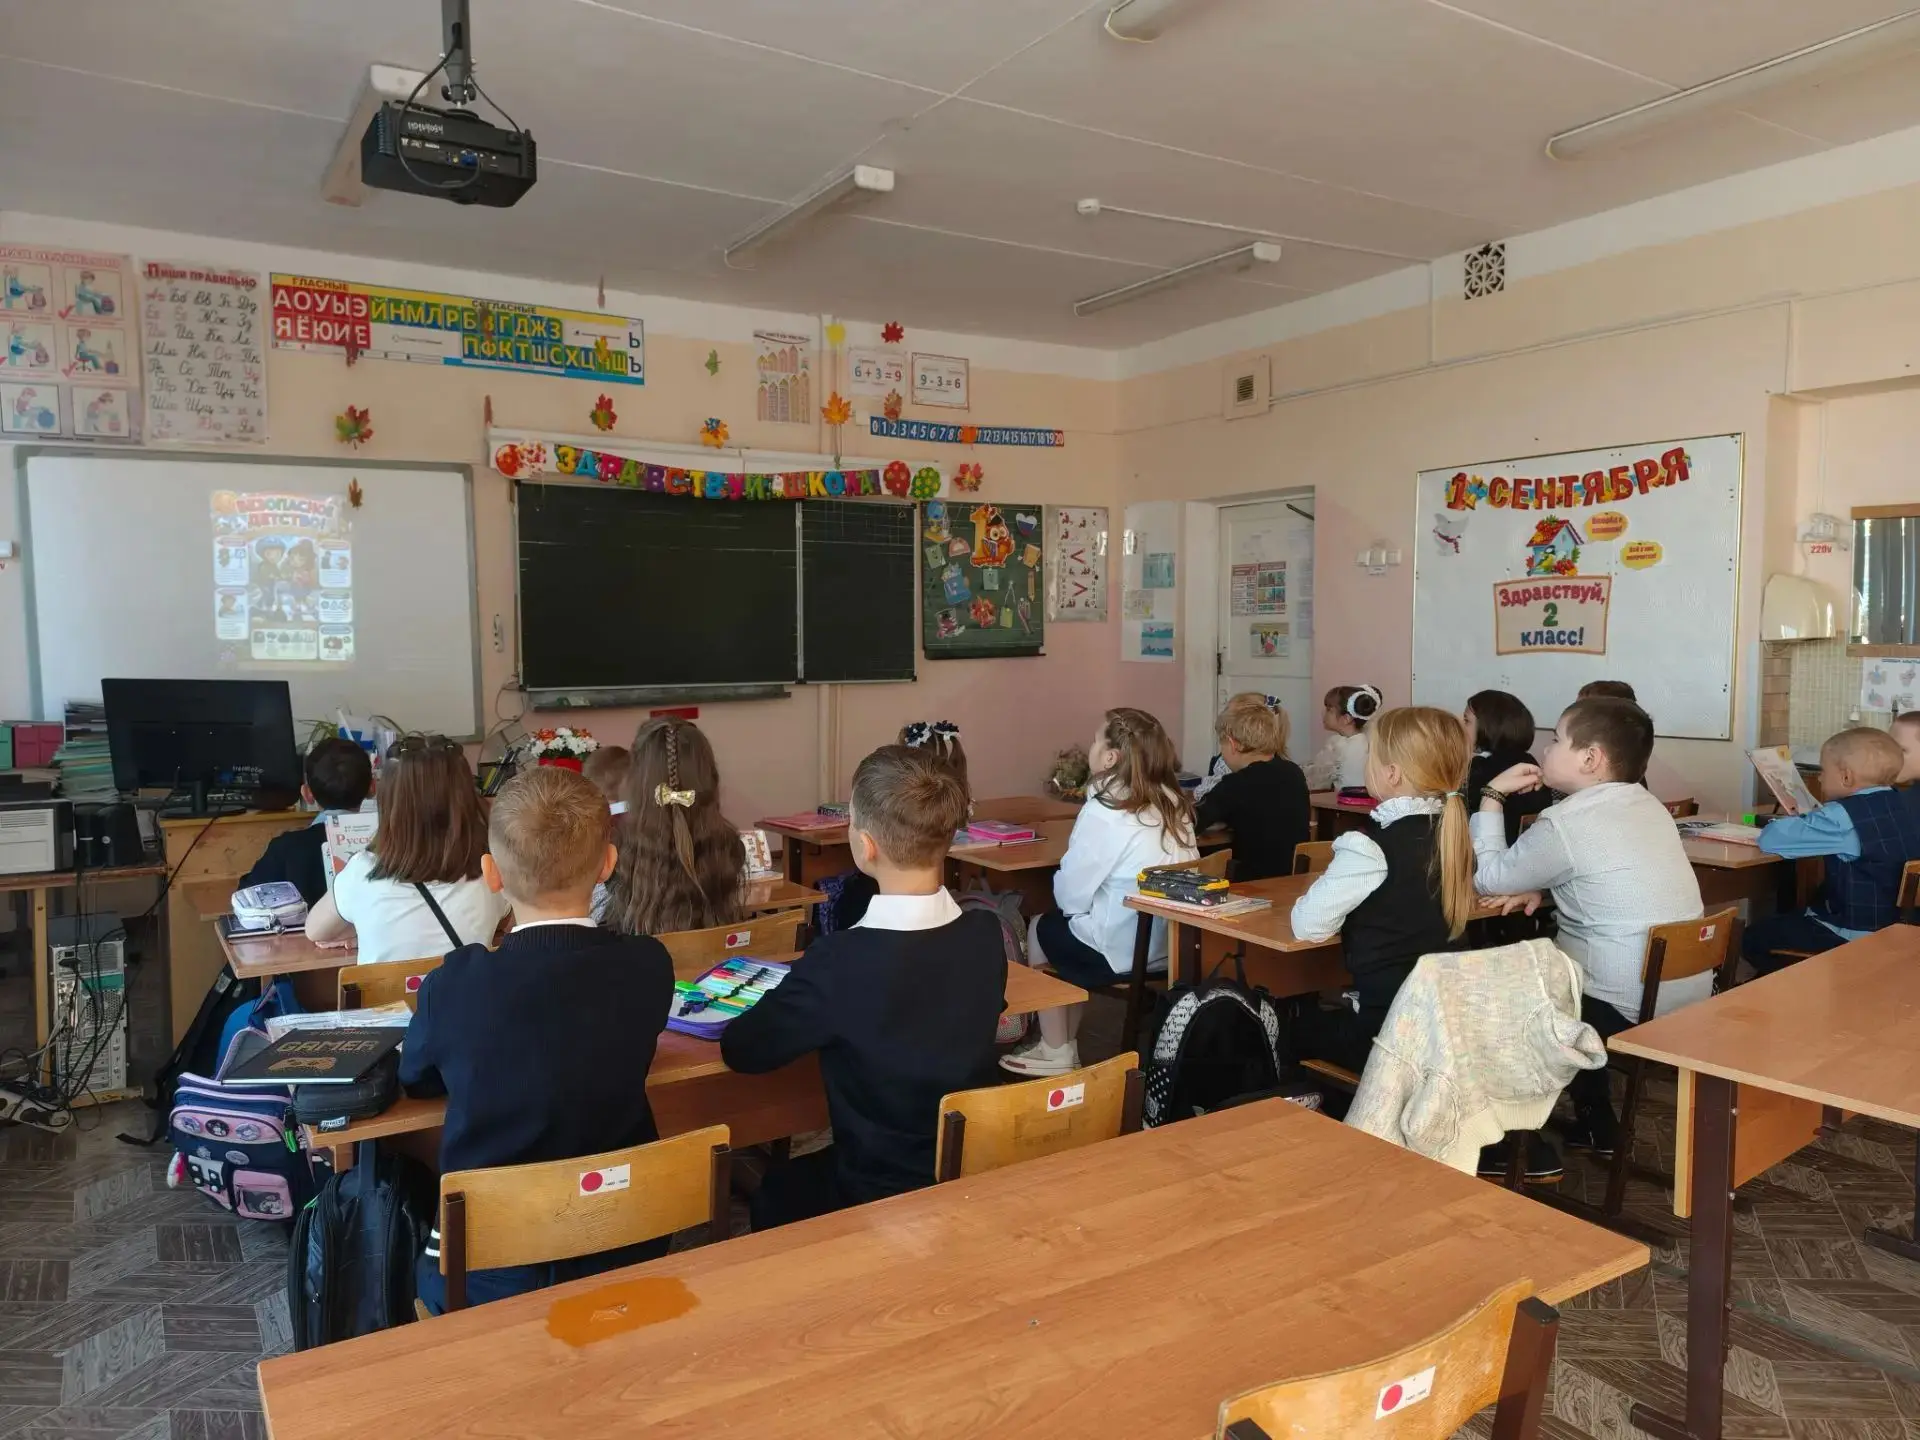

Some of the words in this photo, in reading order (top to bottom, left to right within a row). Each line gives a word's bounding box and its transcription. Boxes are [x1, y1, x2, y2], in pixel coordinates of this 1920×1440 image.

[292, 277, 349, 292] ГЛАСНЫЕ
[854, 366, 862, 378] 6
[876, 367, 882, 380] 3
[894, 370, 902, 382] 9
[920, 374, 928, 386] 9
[936, 376, 943, 387] 3
[954, 378, 961, 389] 6
[555, 444, 765, 499] ЗДРАВСТВУЙ
[1488, 446, 1690, 510] СЕНТЯБРЯ
[1499, 582, 1606, 607] Здравствуй,
[1542, 602, 1558, 627] 2
[1520, 627, 1585, 646] класс!
[277, 1040, 380, 1052] GAMER
